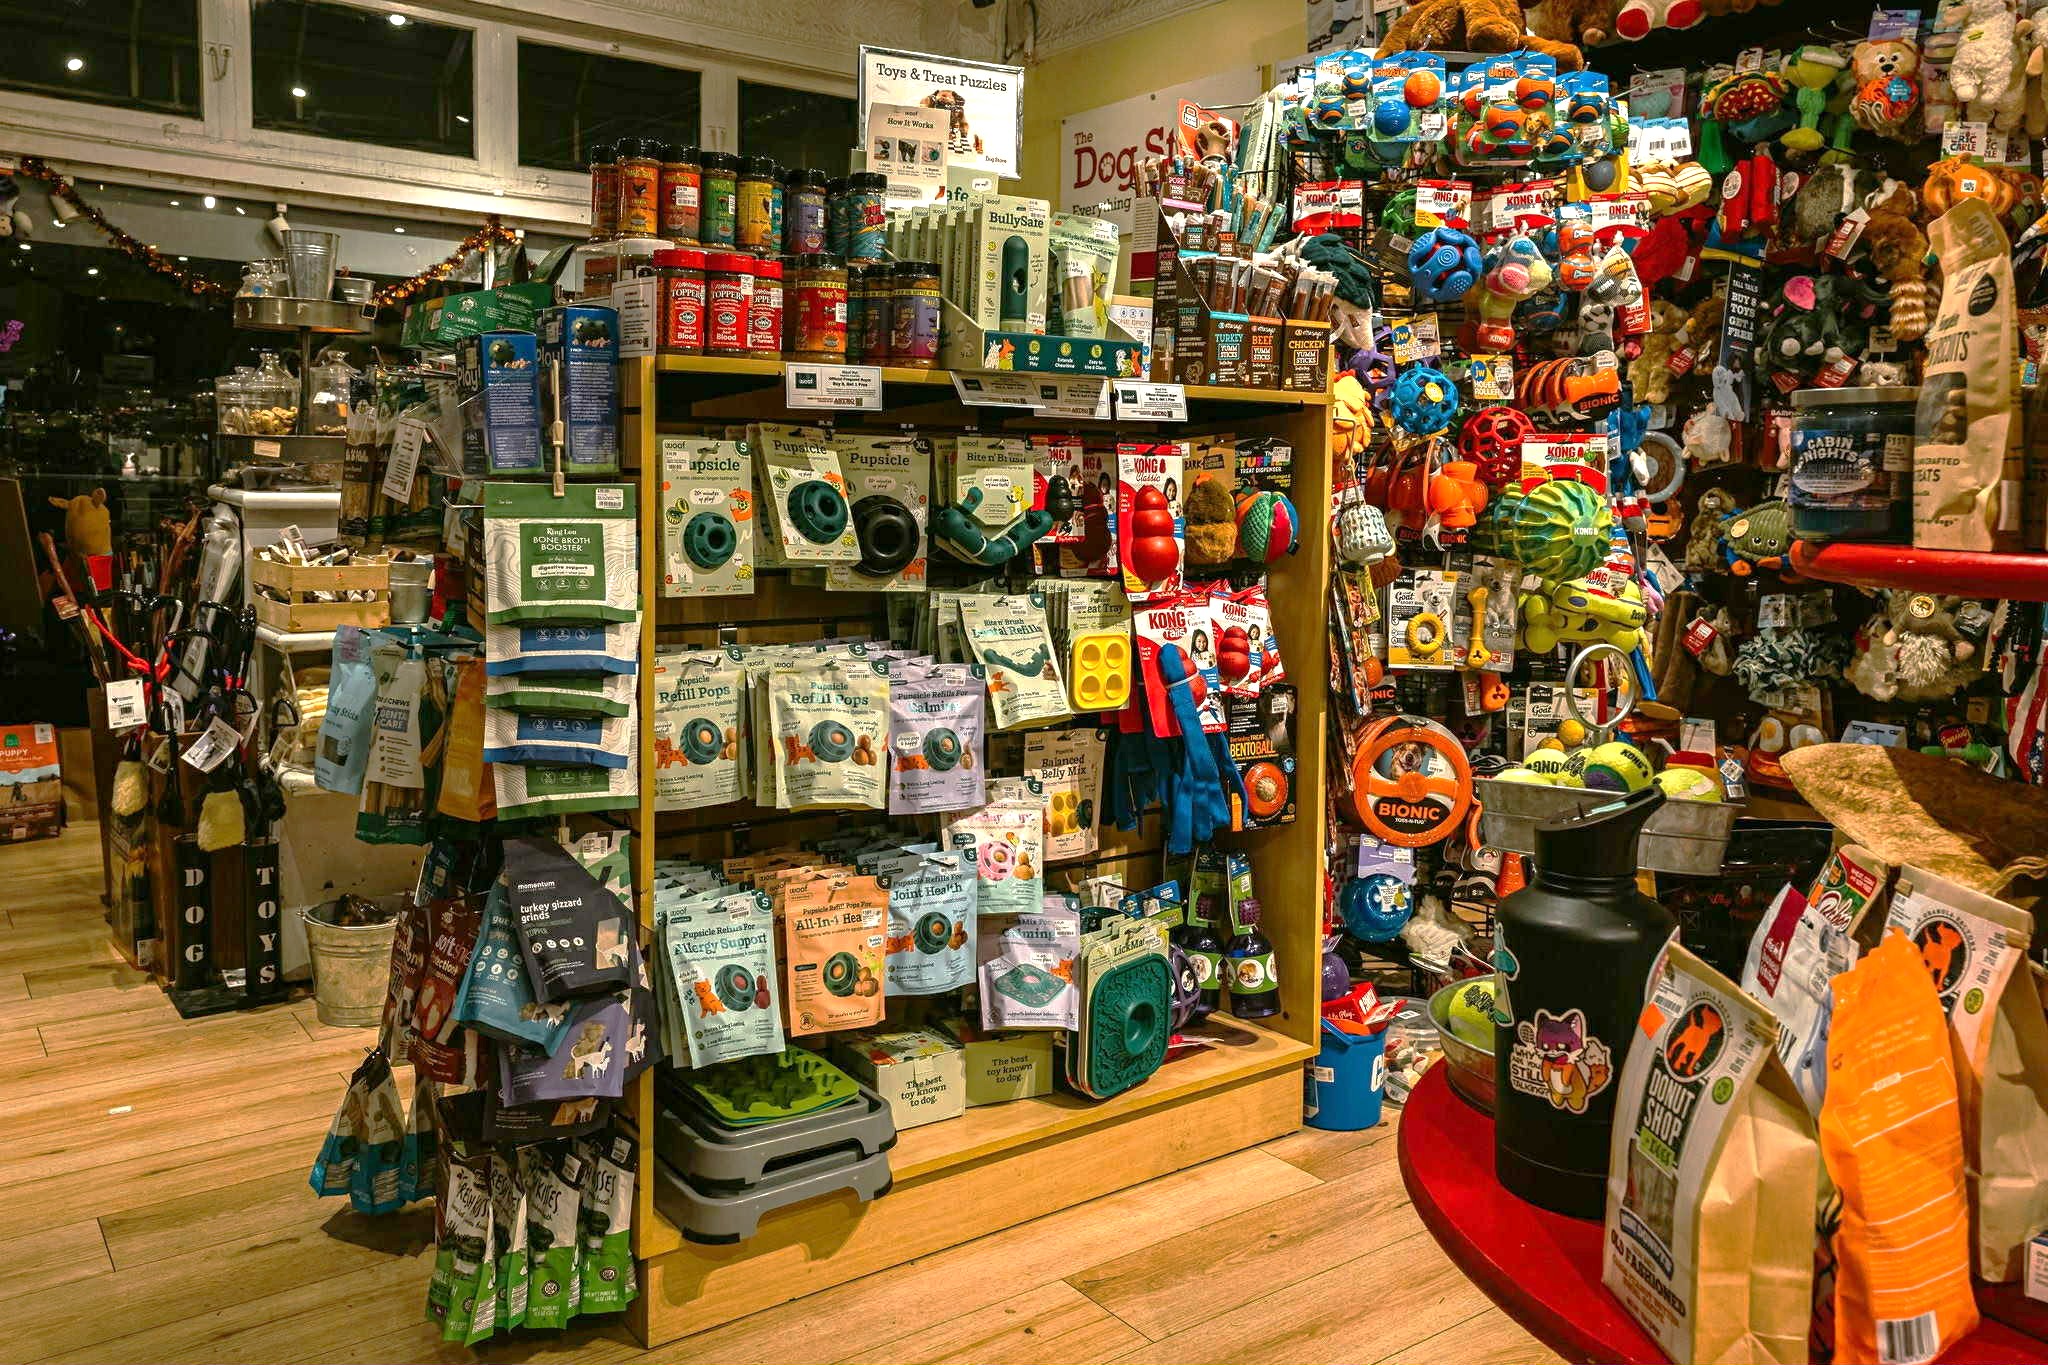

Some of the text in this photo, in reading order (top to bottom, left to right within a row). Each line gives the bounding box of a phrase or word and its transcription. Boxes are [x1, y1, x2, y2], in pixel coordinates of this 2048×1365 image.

[876, 63, 1007, 92] Toys & Treat Puzzles
[888, 118, 903, 127] How
[912, 121, 935, 129] Works
[1074, 132, 1093, 145] The
[1073, 145, 1137, 191] Dog
[1306, 194, 1329, 204] KONG
[1507, 195, 1534, 206] KONG
[1609, 204, 1629, 215] ONG
[989, 212, 1044, 229] BullySafe
[712, 290, 744, 301] TOPPERS
[1731, 292, 1750, 305] BUY
[1730, 302, 1755, 318] TOYS
[1729, 315, 1748, 328] GET
[677, 332, 696, 340] Blood
[717, 333, 736, 341] Blood
[1215, 334, 1243, 342] TURKEY
[1727, 326, 1753, 341] FREE
[1252, 336, 1274, 345] BEEF
[1289, 340, 1325, 349] CHICKEN
[1396, 346, 1427, 357] ROLLER
[1580, 394, 1619, 411] BIONIC
[664, 441, 686, 449] woof
[741, 443, 747, 451] S
[774, 439, 828, 455] Pupsicle
[916, 440, 928, 449] XL
[1808, 436, 1853, 450] CABIN
[967, 453, 987, 462] Bite
[1548, 447, 1576, 457] KONG
[1802, 448, 1858, 463] NIGHTS
[689, 457, 740, 474] upsicle
[850, 453, 910, 467] Pupsicle
[1134, 458, 1158, 473] KONG
[1136, 473, 1161, 482] Classic
[1574, 527, 1593, 536] KONG
[533, 536, 559, 544] BONE
[541, 543, 583, 552] BOOSTER
[1395, 591, 1415, 604] Goat
[1103, 603, 1123, 614] Tray
[1223, 603, 1247, 618] KONG
[1005, 618, 1024, 626] Brush
[1149, 611, 1185, 630] KONG
[1225, 614, 1249, 625] Classic
[972, 624, 1042, 639] Dtal Refills
[732, 650, 740, 659] S
[855, 645, 862, 653] S
[774, 661, 795, 669] woof
[878, 664, 885, 673] S
[677, 676, 710, 687] Pupsicle
[810, 682, 848, 691] Pupsicle
[659, 685, 731, 704] Refill Pops
[835, 693, 869, 707] Pops
[898, 691, 930, 701] Pupsicle
[932, 690, 950, 699] Refills
[388, 698, 410, 707] CHEWS
[1532, 704, 1551, 718] Goat
[1250, 733, 1265, 741] TREAT
[1041, 755, 1085, 768] Balanced
[1041, 766, 1087, 779] Belly Mix
[1033, 783, 1039, 791] S
[1378, 803, 1440, 820] BIONIC
[968, 851, 974, 859] S
[881, 862, 899, 870] woof
[518, 880, 555, 890] momentum
[893, 873, 962, 888] Pupsicle Refills For
[789, 886, 808, 894] woof
[892, 882, 962, 902] Joint Health
[520, 897, 582, 915] turkey gizzard
[762, 899, 769, 908] S
[184, 867, 205, 963] DOG
[670, 908, 687, 916] woof
[803, 906, 828, 915] Pupsicle
[521, 911, 550, 924] grinds
[796, 911, 862, 932] All-In-1 Hea
[257, 866, 277, 985] TOYS
[682, 928, 715, 940] Pupsicle
[743, 923, 755, 931] For
[673, 934, 767, 956] Allergy Support
[1114, 937, 1145, 955] LickMat
[1515, 1048, 1534, 1060] WHY
[992, 1055, 1029, 1067] The best
[1527, 1059, 1541, 1069] YOU
[986, 1063, 1033, 1078] toy known
[906, 1075, 943, 1089] The best
[995, 1073, 1024, 1084] to dog.
[901, 1083, 947, 1101] toy known
[1648, 1068, 1696, 1119] DONUT
[910, 1094, 938, 1107] to dog.
[1643, 1097, 1682, 1147] SHOP
[1626, 1244, 1686, 1318] FASHIONED
